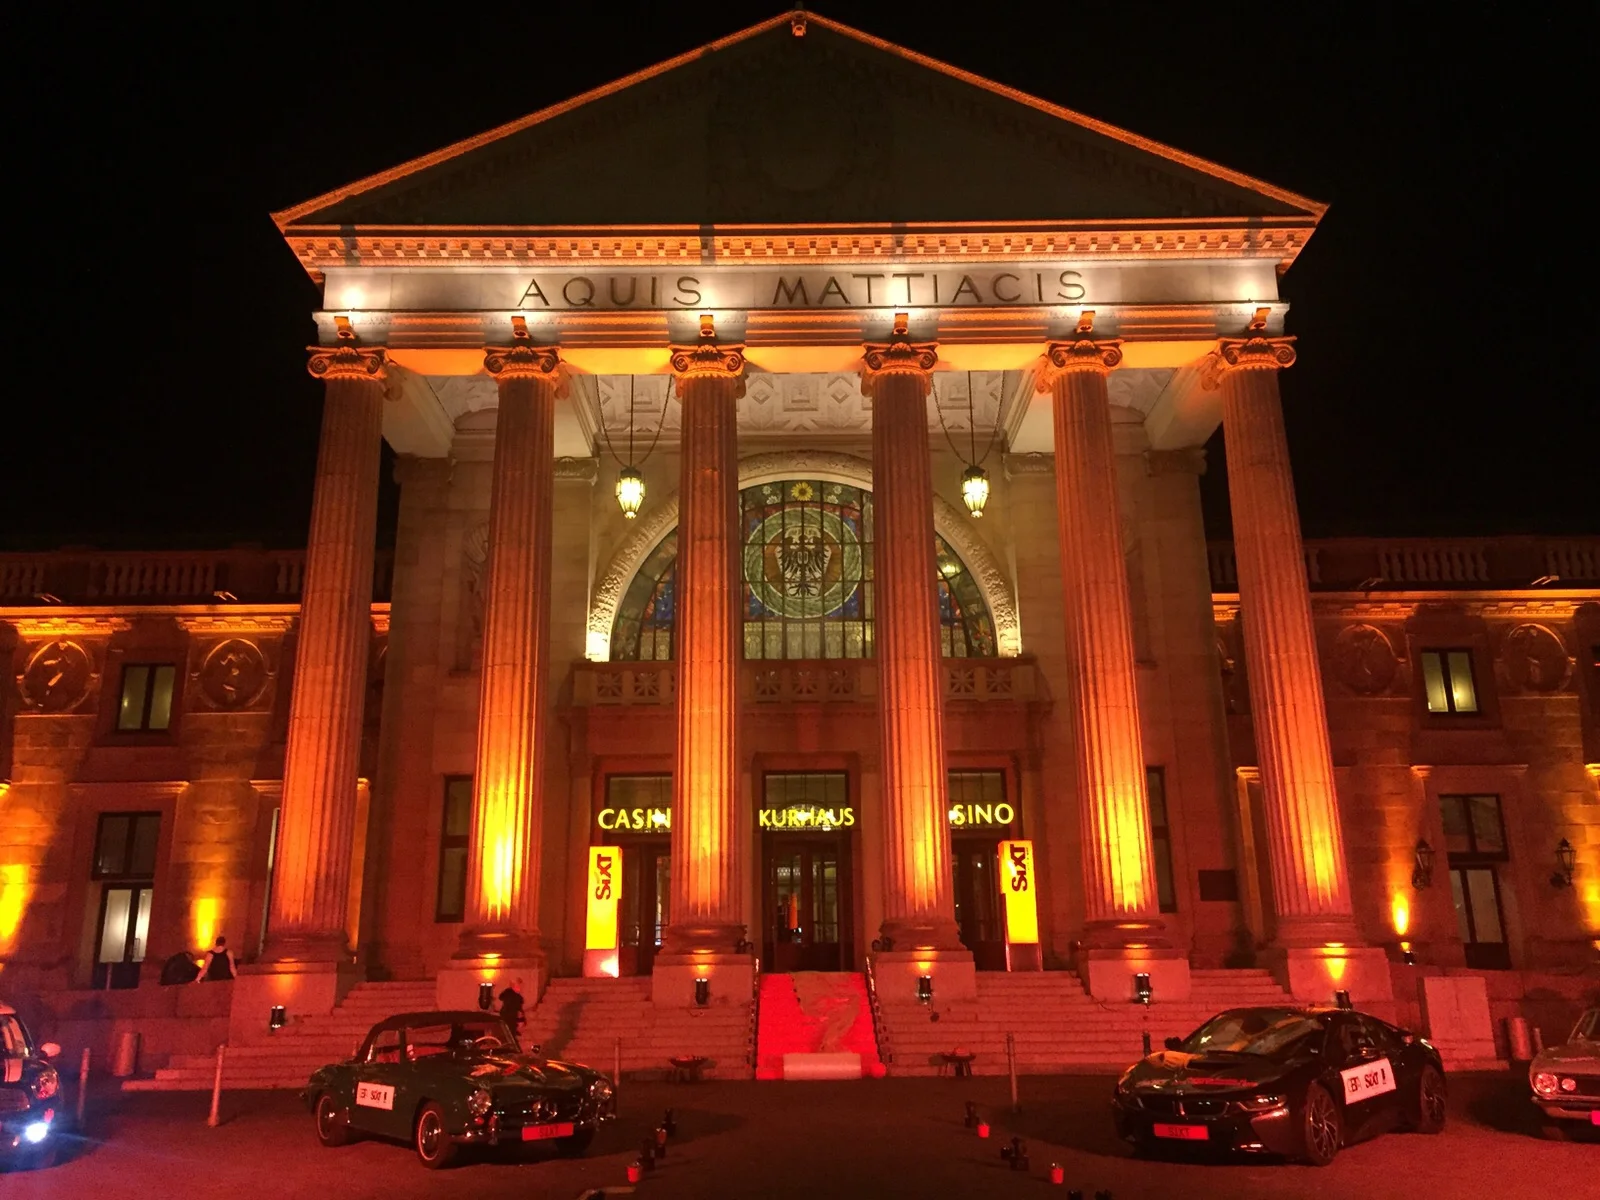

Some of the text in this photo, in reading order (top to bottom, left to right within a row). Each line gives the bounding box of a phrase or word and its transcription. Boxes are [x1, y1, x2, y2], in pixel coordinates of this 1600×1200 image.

[517, 270, 1086, 307] AQUIS MATTIACIS
[597, 807, 672, 830] CASIN
[759, 807, 855, 827] KURHAUS
[948, 803, 1014, 825] SINO
[595, 853, 612, 900] SIXT
[1009, 843, 1028, 892] SIXT
